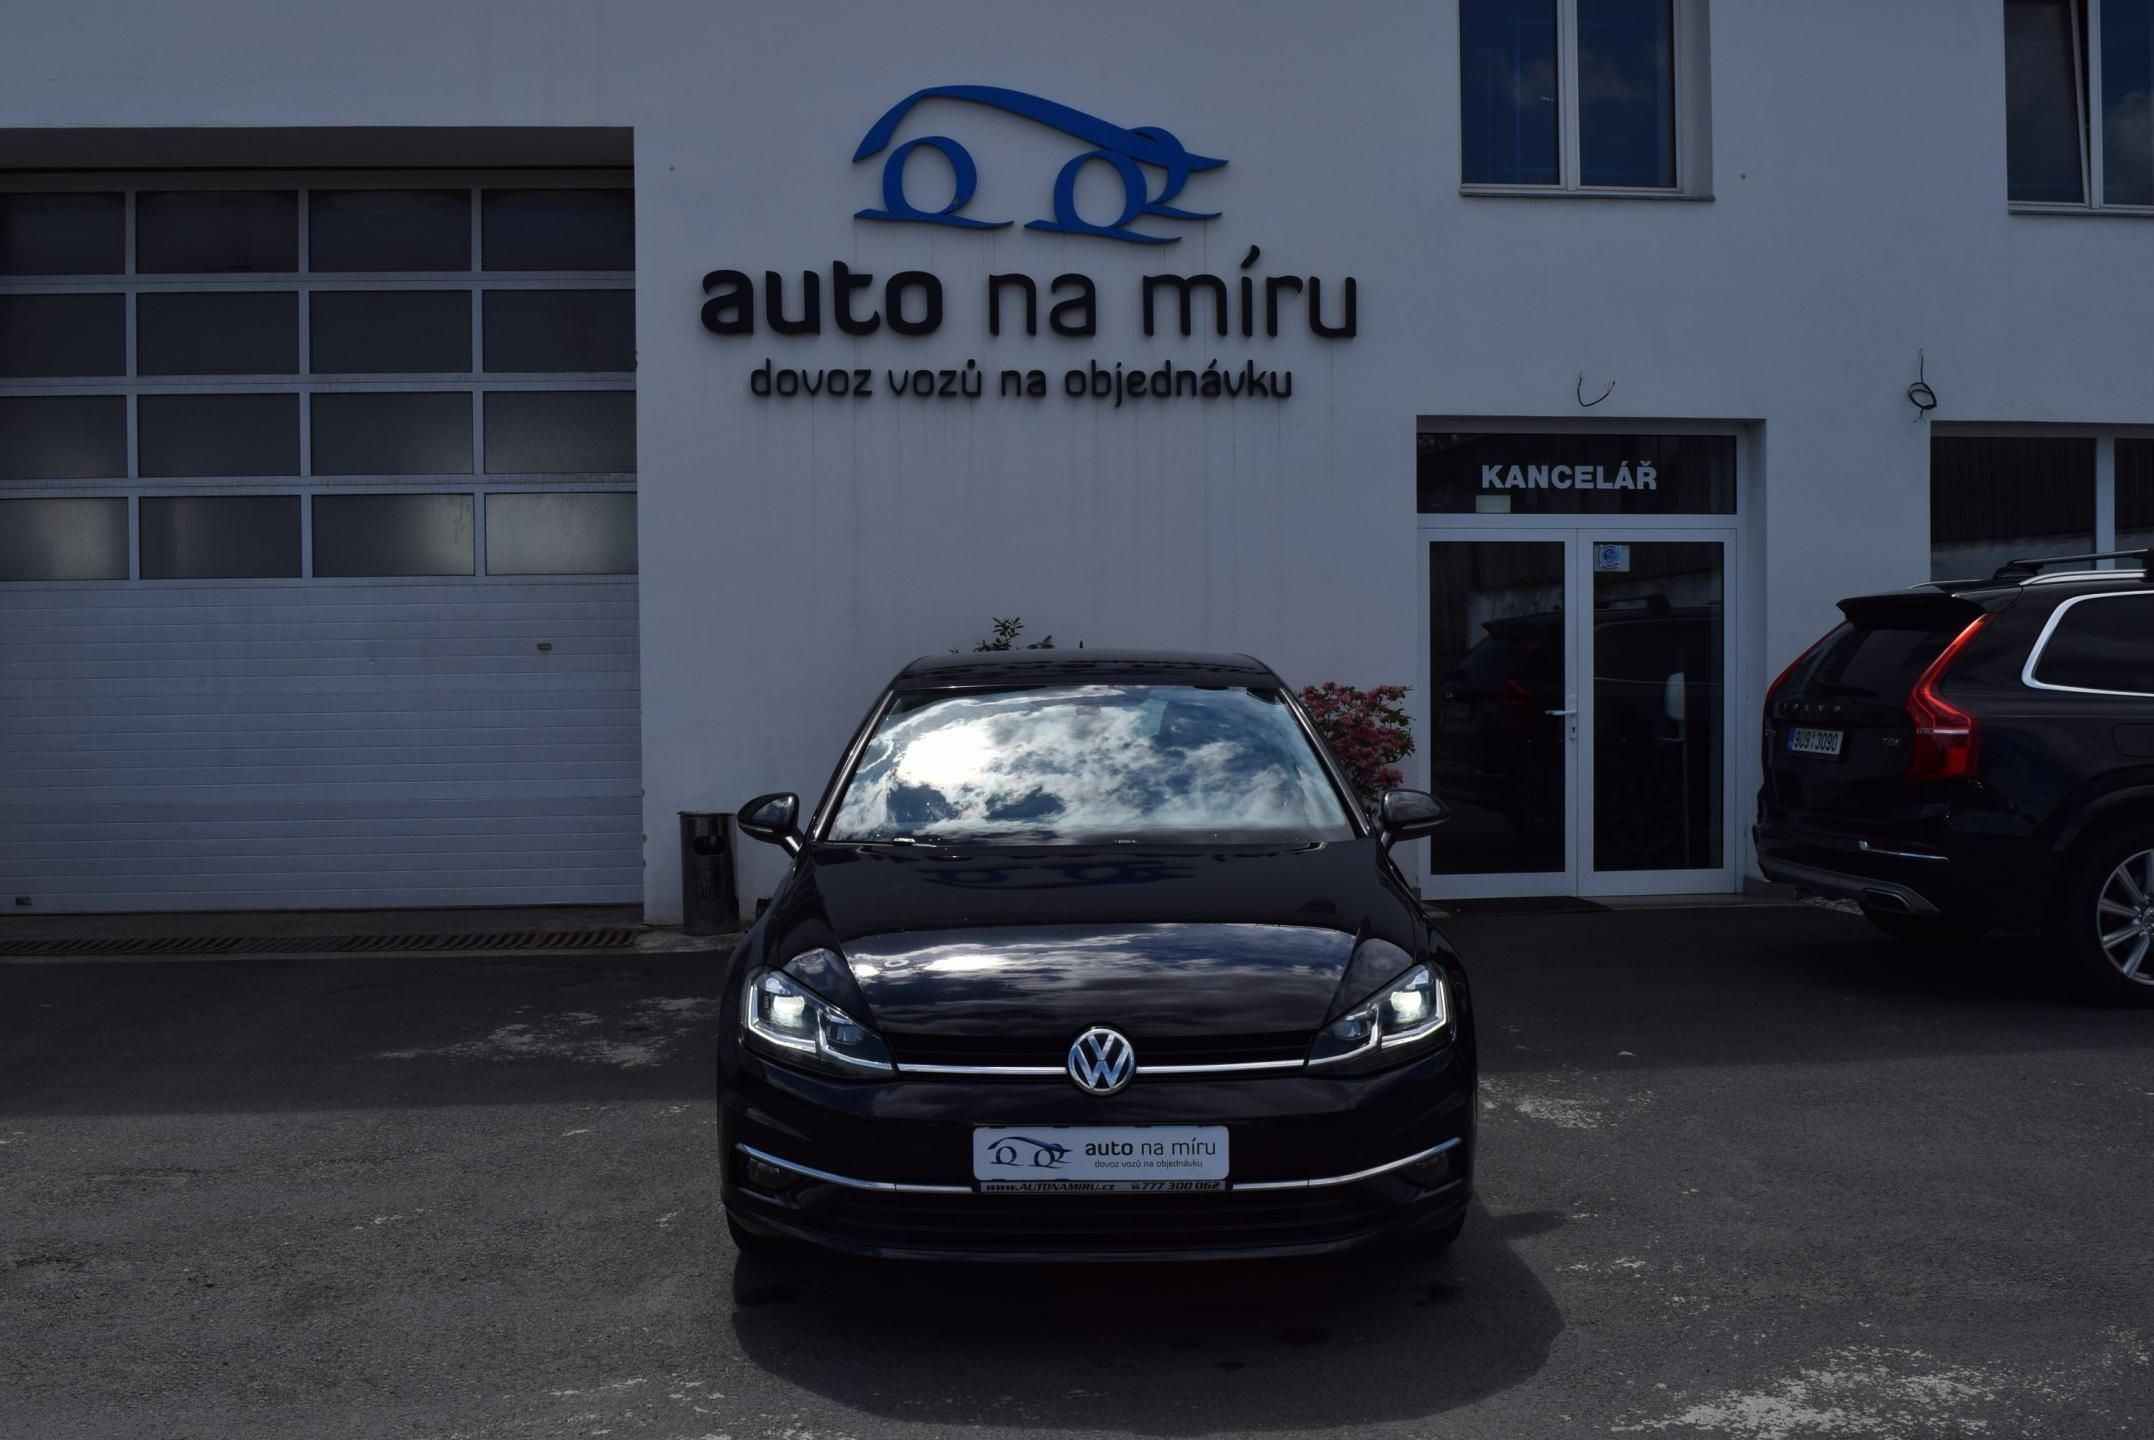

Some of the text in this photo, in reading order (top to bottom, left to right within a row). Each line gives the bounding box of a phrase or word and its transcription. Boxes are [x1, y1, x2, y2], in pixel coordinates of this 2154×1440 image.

[700, 244, 1358, 338] auto na míru
[750, 359, 1293, 408] dovoz vozů na objednávku
[1481, 460, 1658, 490] KANCELÁŘ
[1085, 1137, 1216, 1156] auto na míru
[1094, 1159, 1120, 1168] dovoz
[1143, 1160, 1155, 1168] na
[1141, 1182, 1165, 1191] 777
